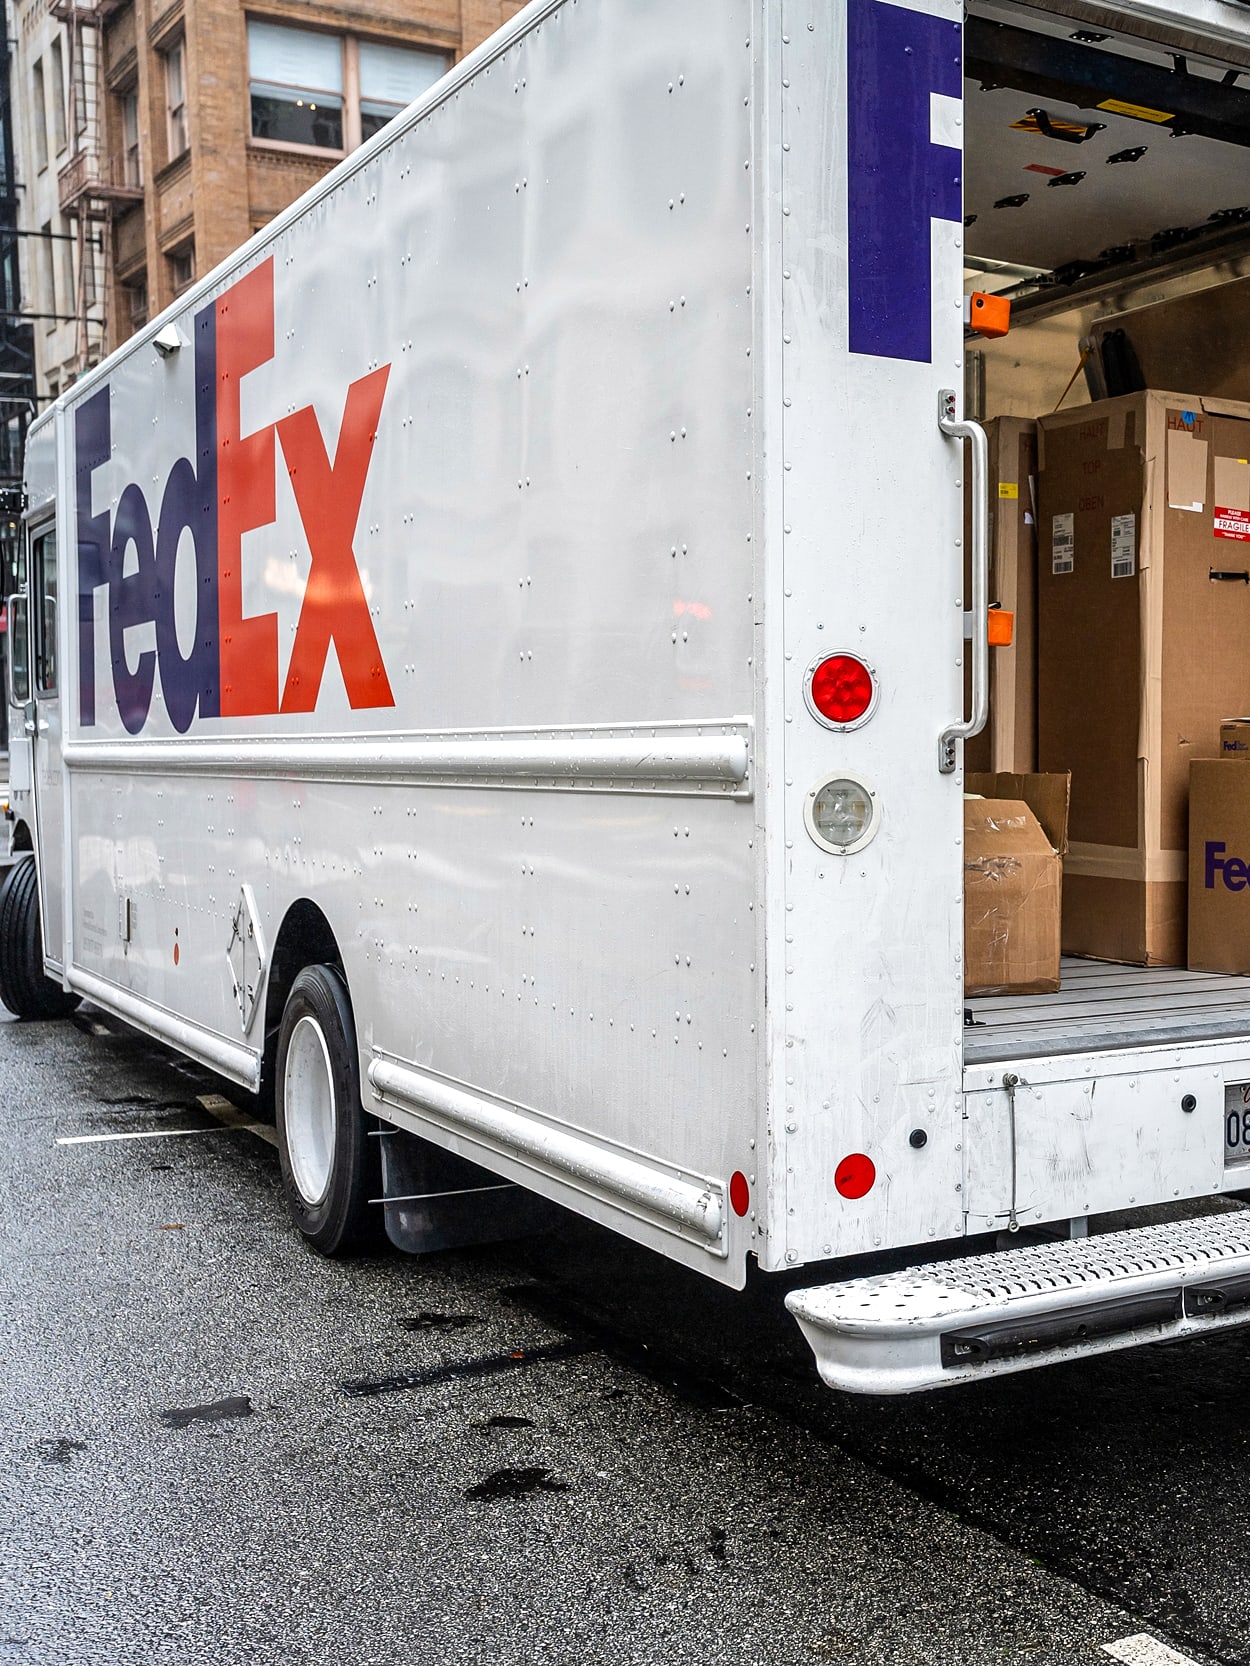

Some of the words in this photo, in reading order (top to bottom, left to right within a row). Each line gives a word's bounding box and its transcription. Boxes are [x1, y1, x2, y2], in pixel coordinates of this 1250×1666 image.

[1082, 460, 1101, 475] TOP
[75, 255, 397, 736] FedEx
[1218, 520, 1250, 533] FRAGILE
